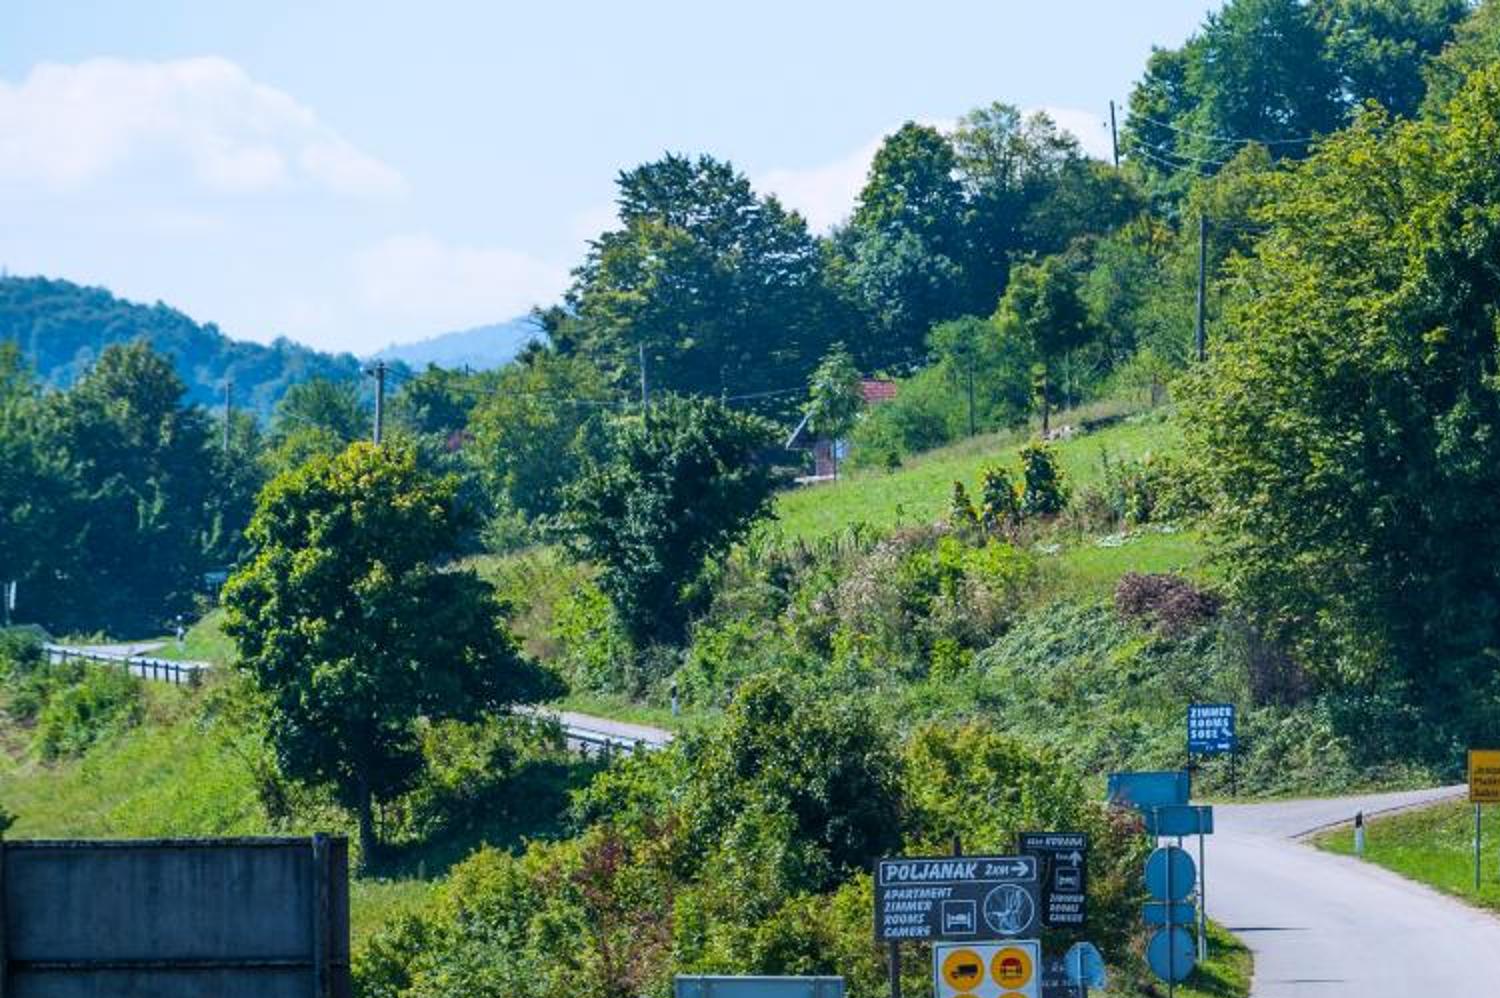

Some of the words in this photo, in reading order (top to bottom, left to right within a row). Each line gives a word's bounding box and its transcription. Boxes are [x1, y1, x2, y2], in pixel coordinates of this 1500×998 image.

[1190, 707, 1232, 718] ZIMMER
[1190, 718, 1229, 728] ROOMS
[886, 862, 978, 880] POLJANAK
[884, 888, 953, 900] APARTMENT
[884, 902, 932, 912] ZIMMER
[884, 914, 926, 925] ROOMS
